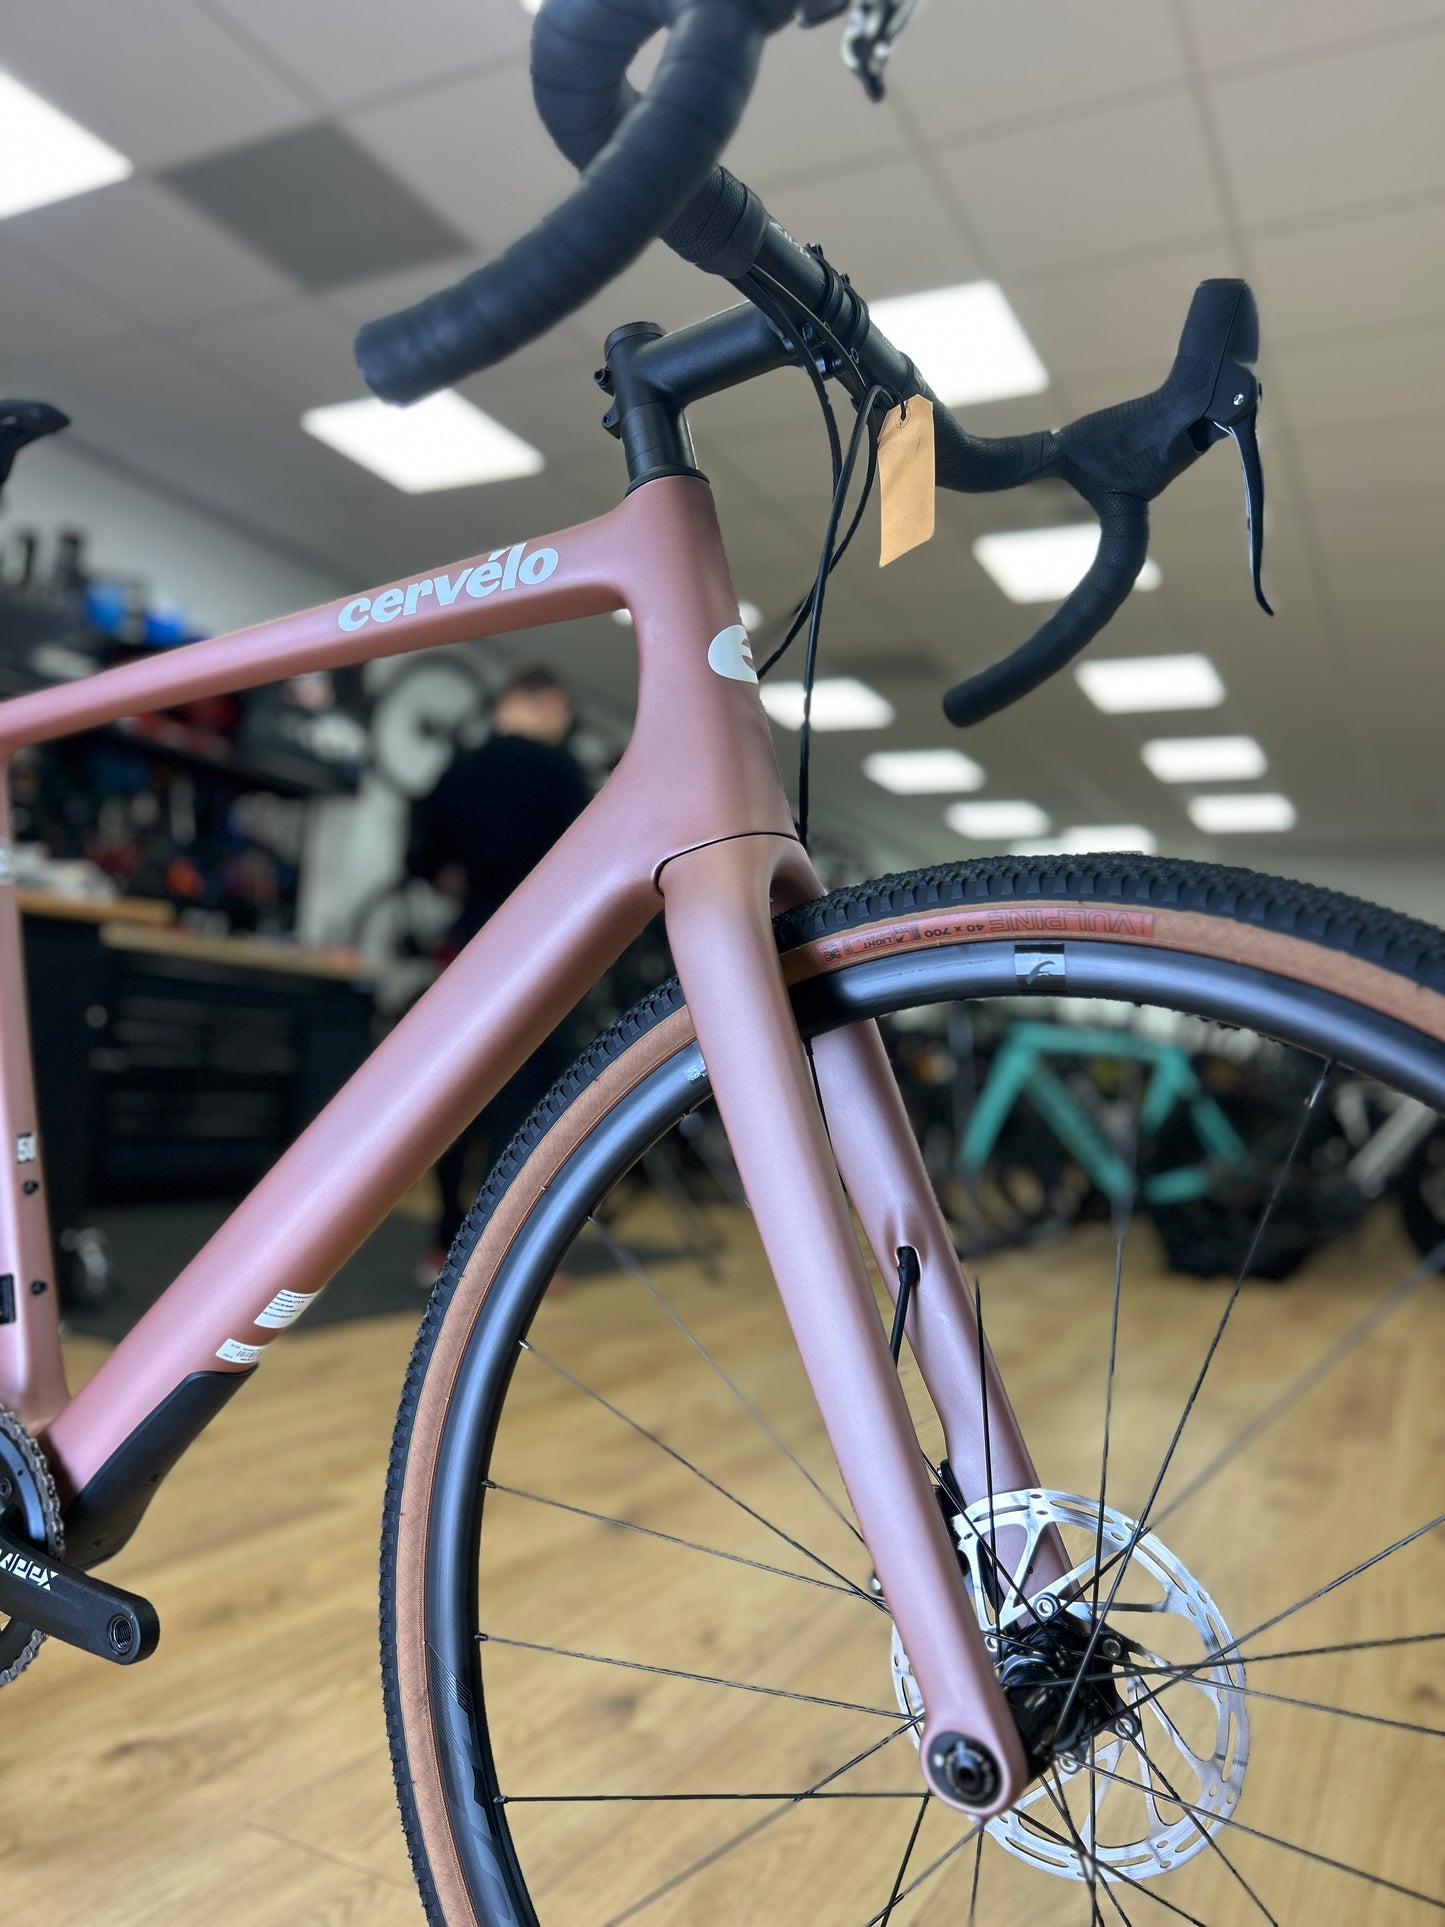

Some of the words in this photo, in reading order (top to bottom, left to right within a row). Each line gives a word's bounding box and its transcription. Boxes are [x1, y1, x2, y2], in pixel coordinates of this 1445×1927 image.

[337, 542, 559, 632] cervélo
[967, 924, 985, 932] 40
[988, 909, 1137, 935] VULPINE
[924, 927, 951, 938] 700
[862, 937, 893, 949] LIGHT
